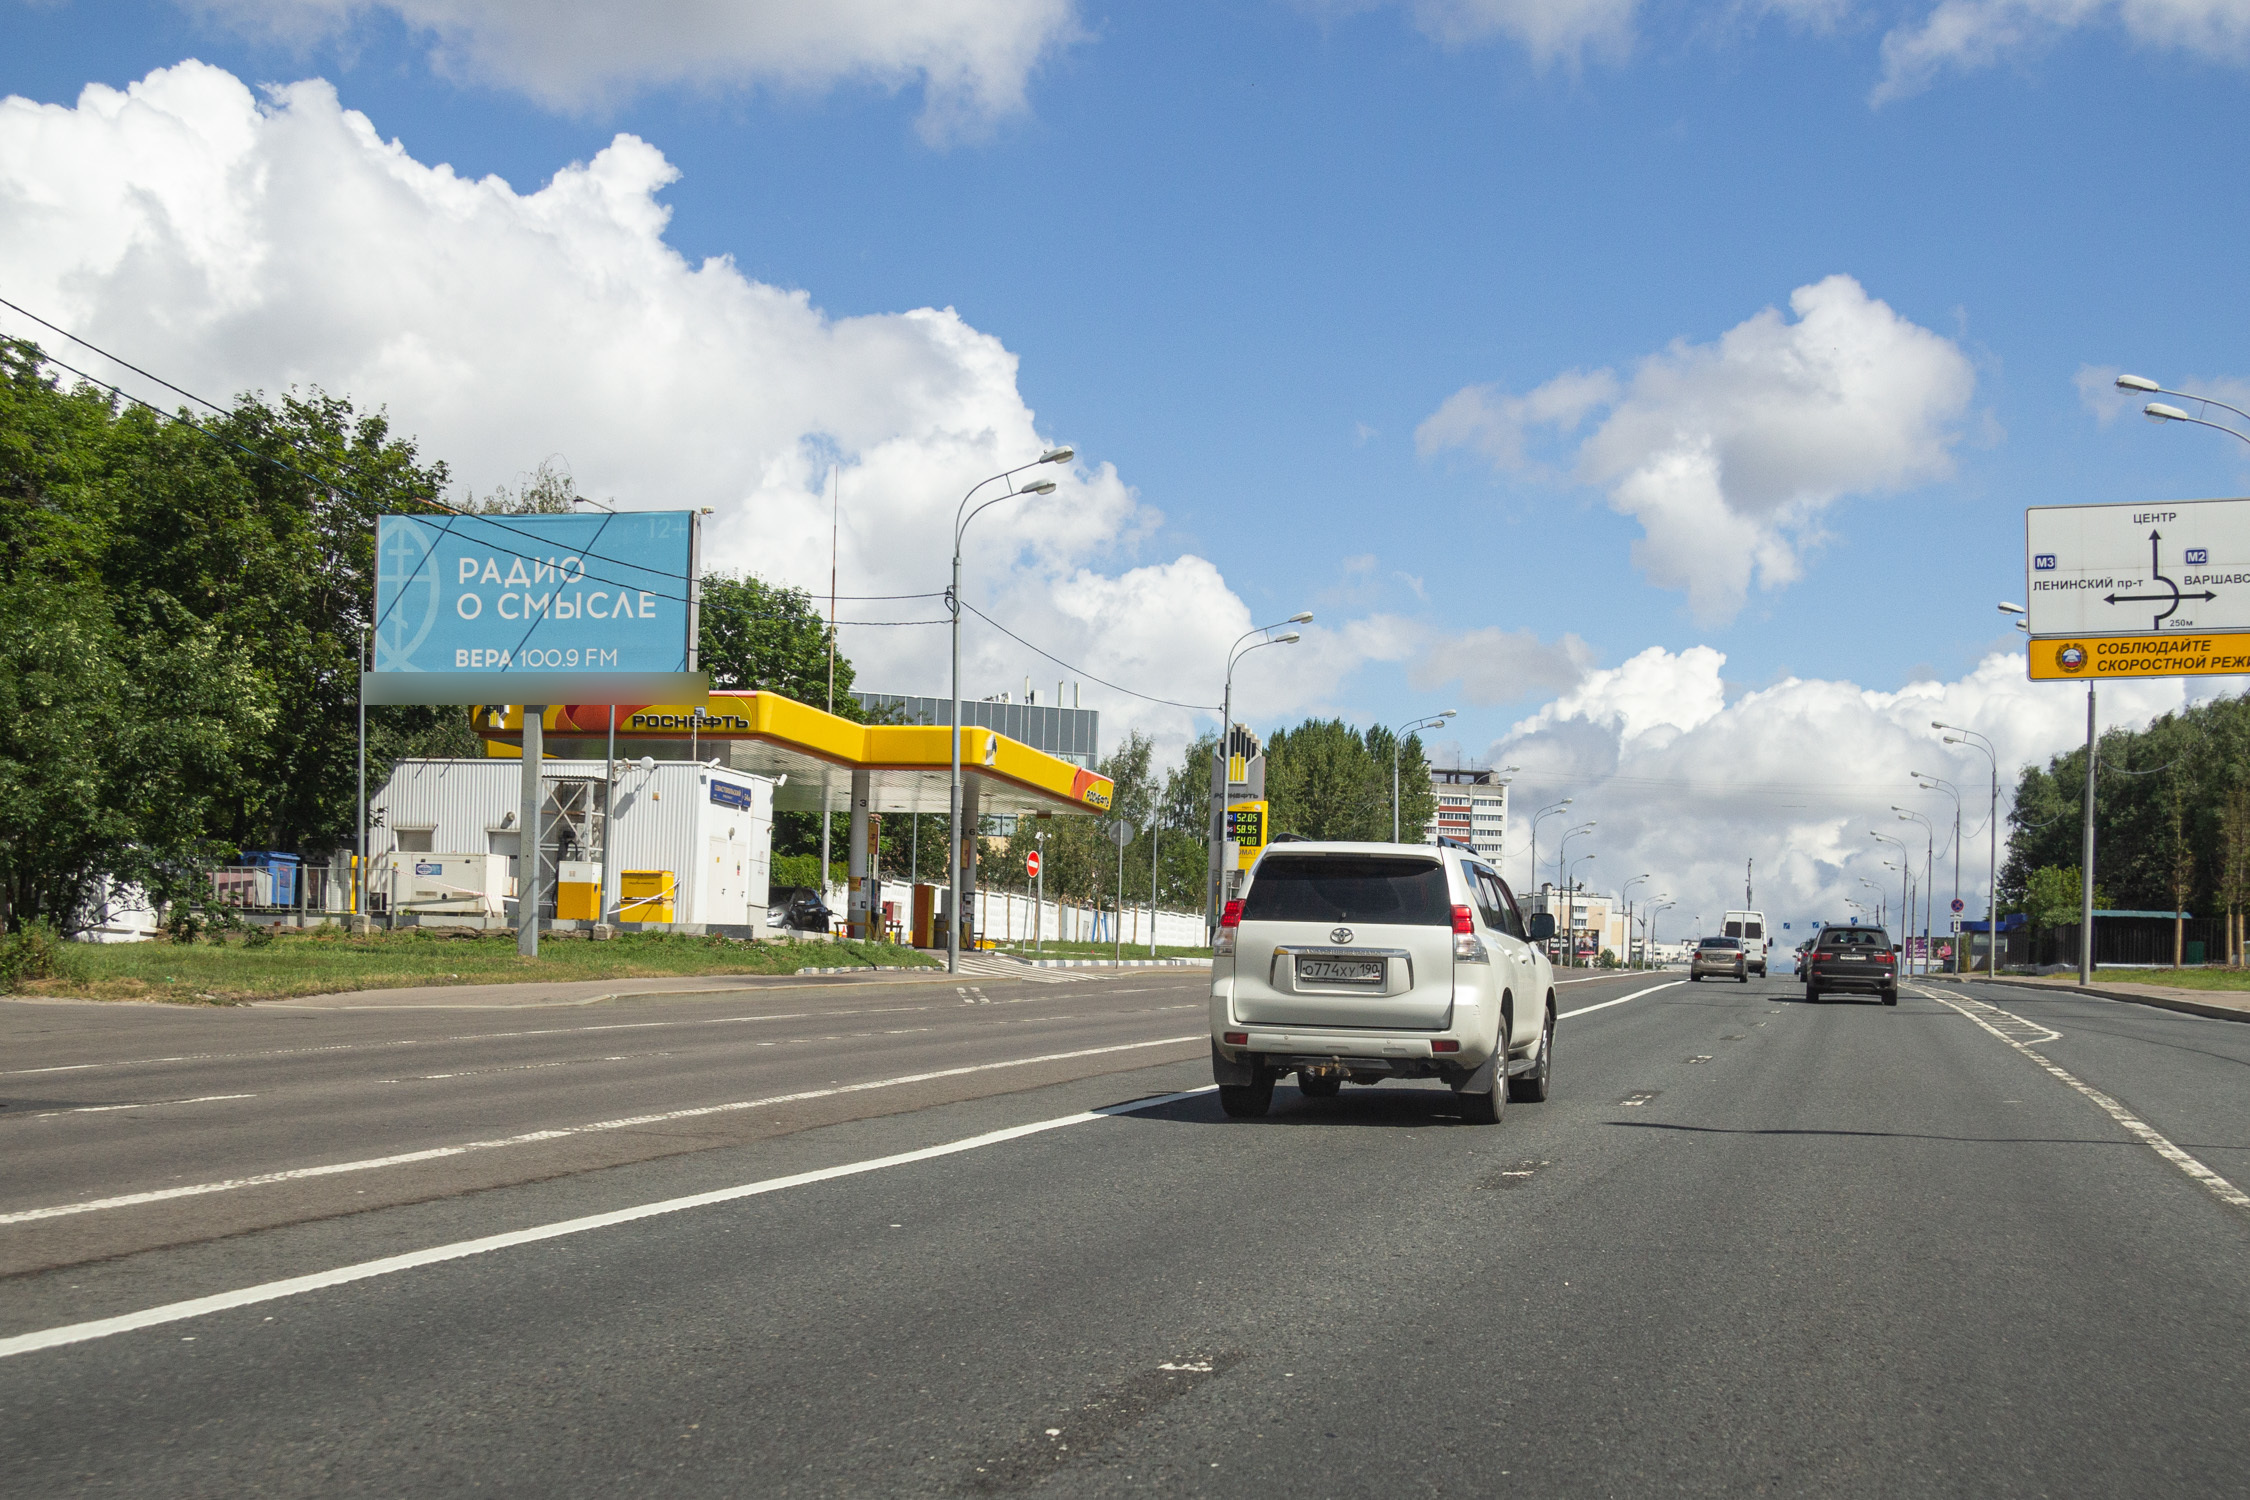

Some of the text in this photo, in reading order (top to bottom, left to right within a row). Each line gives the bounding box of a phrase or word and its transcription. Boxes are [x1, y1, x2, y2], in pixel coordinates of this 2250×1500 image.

[2133, 512, 2177, 525] ЦЕНТР
[649, 518, 688, 539] 12+
[2036, 557, 2054, 568] М3
[2187, 551, 2206, 562] М2
[459, 556, 585, 588] РАДИО
[2033, 576, 2144, 591] ЛЕНИНСКИЙ пр-т
[457, 591, 656, 620] О СМЫСЛЕ
[2169, 619, 2193, 627] 250м
[2097, 638, 2211, 656] СОБЛЮДАЙТЕ
[455, 648, 618, 667] ВЕРА 100.9 FM
[2097, 655, 2206, 672] СКОРОСТНОЙ
[632, 715, 750, 729] РОСНЕФТЬ
[1236, 812, 1258, 823] 52.05
[1236, 824, 1257, 834] 58.95
[1360, 963, 1379, 974] 190
